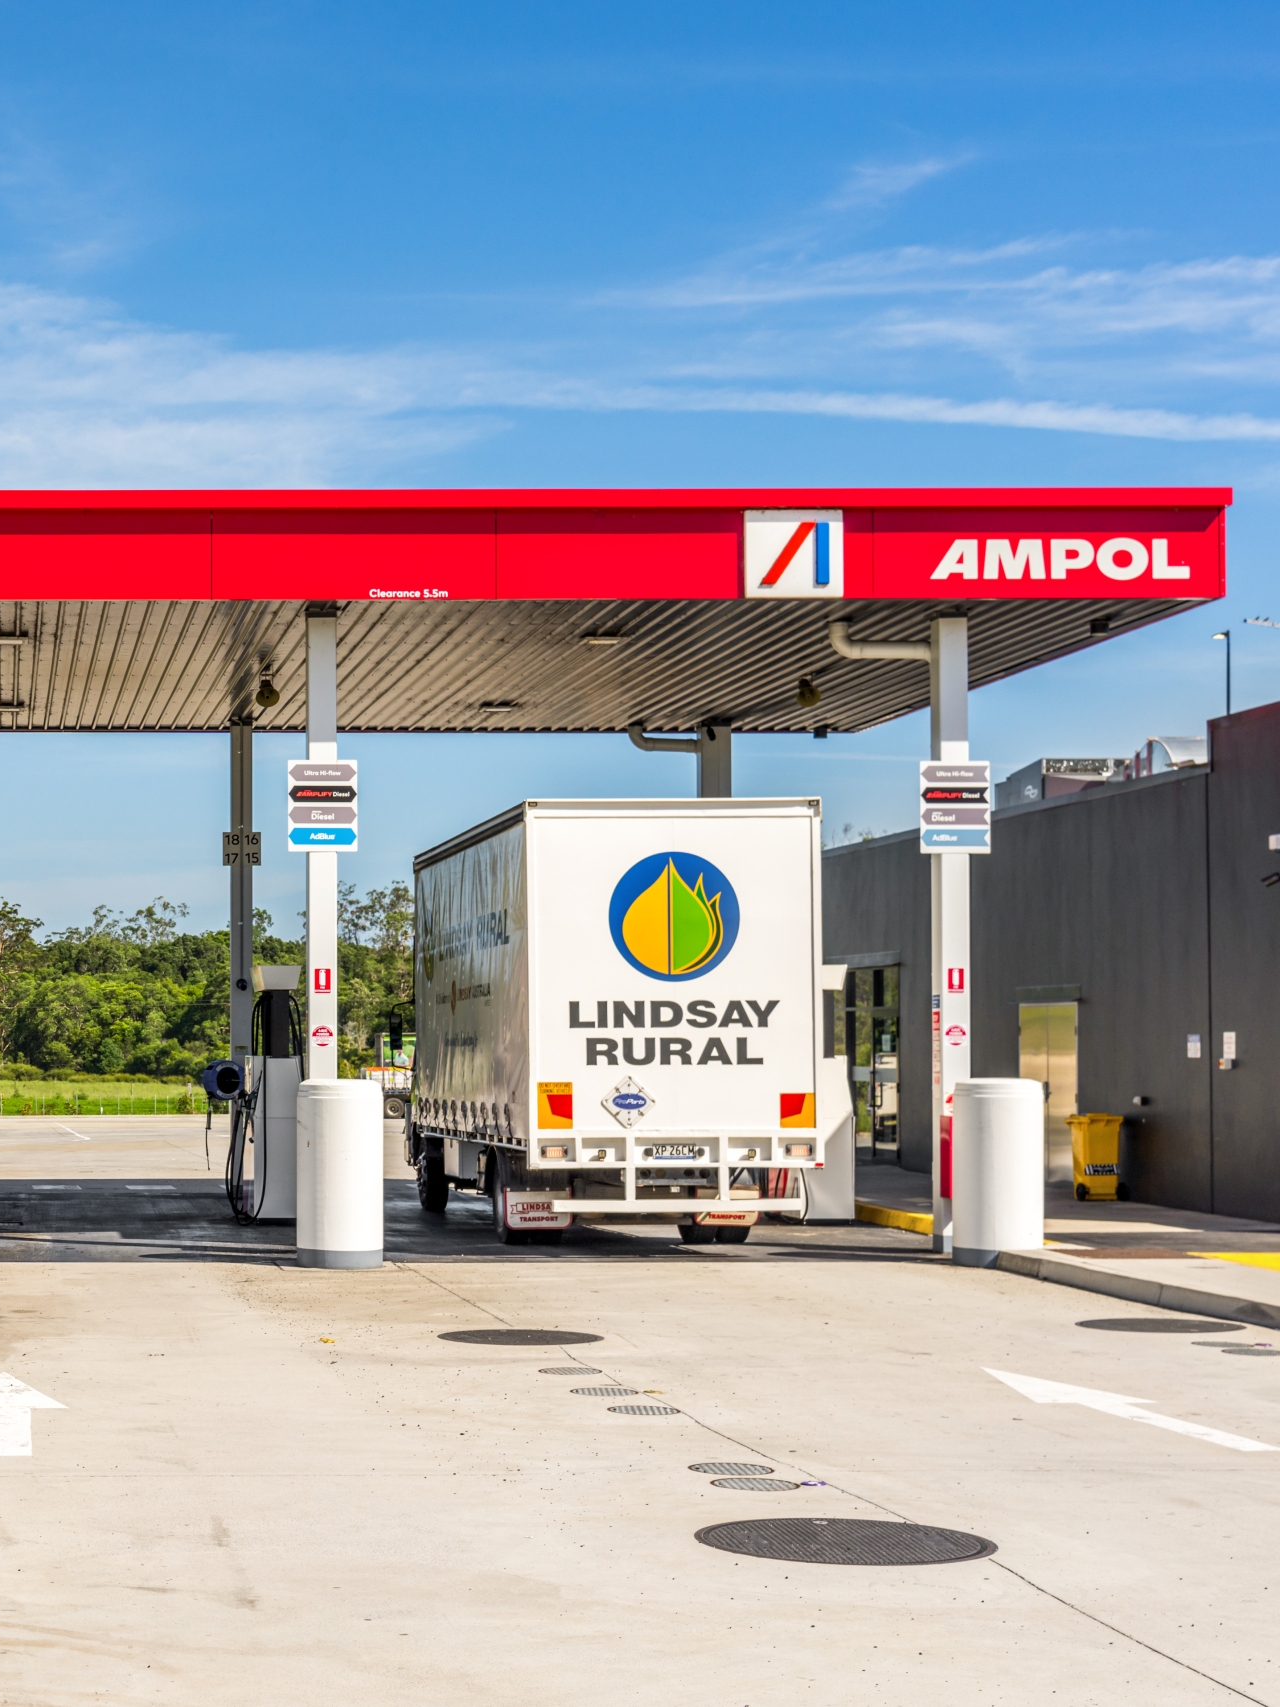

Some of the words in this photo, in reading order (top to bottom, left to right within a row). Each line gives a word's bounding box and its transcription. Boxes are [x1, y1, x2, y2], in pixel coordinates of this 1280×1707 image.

[930, 537, 1191, 581] AMPOL
[369, 588, 421, 598] Clearance
[423, 588, 448, 598] 5.5m
[931, 814, 955, 822] Diesel
[225, 834, 240, 846] 18
[244, 834, 259, 845] 16
[309, 832, 335, 840] AdBlue
[225, 853, 239, 864] 17
[245, 852, 259, 864] 15
[477, 909, 510, 951] RURAL
[568, 1000, 780, 1029] LINDSAY
[586, 1037, 764, 1066] RURAL
